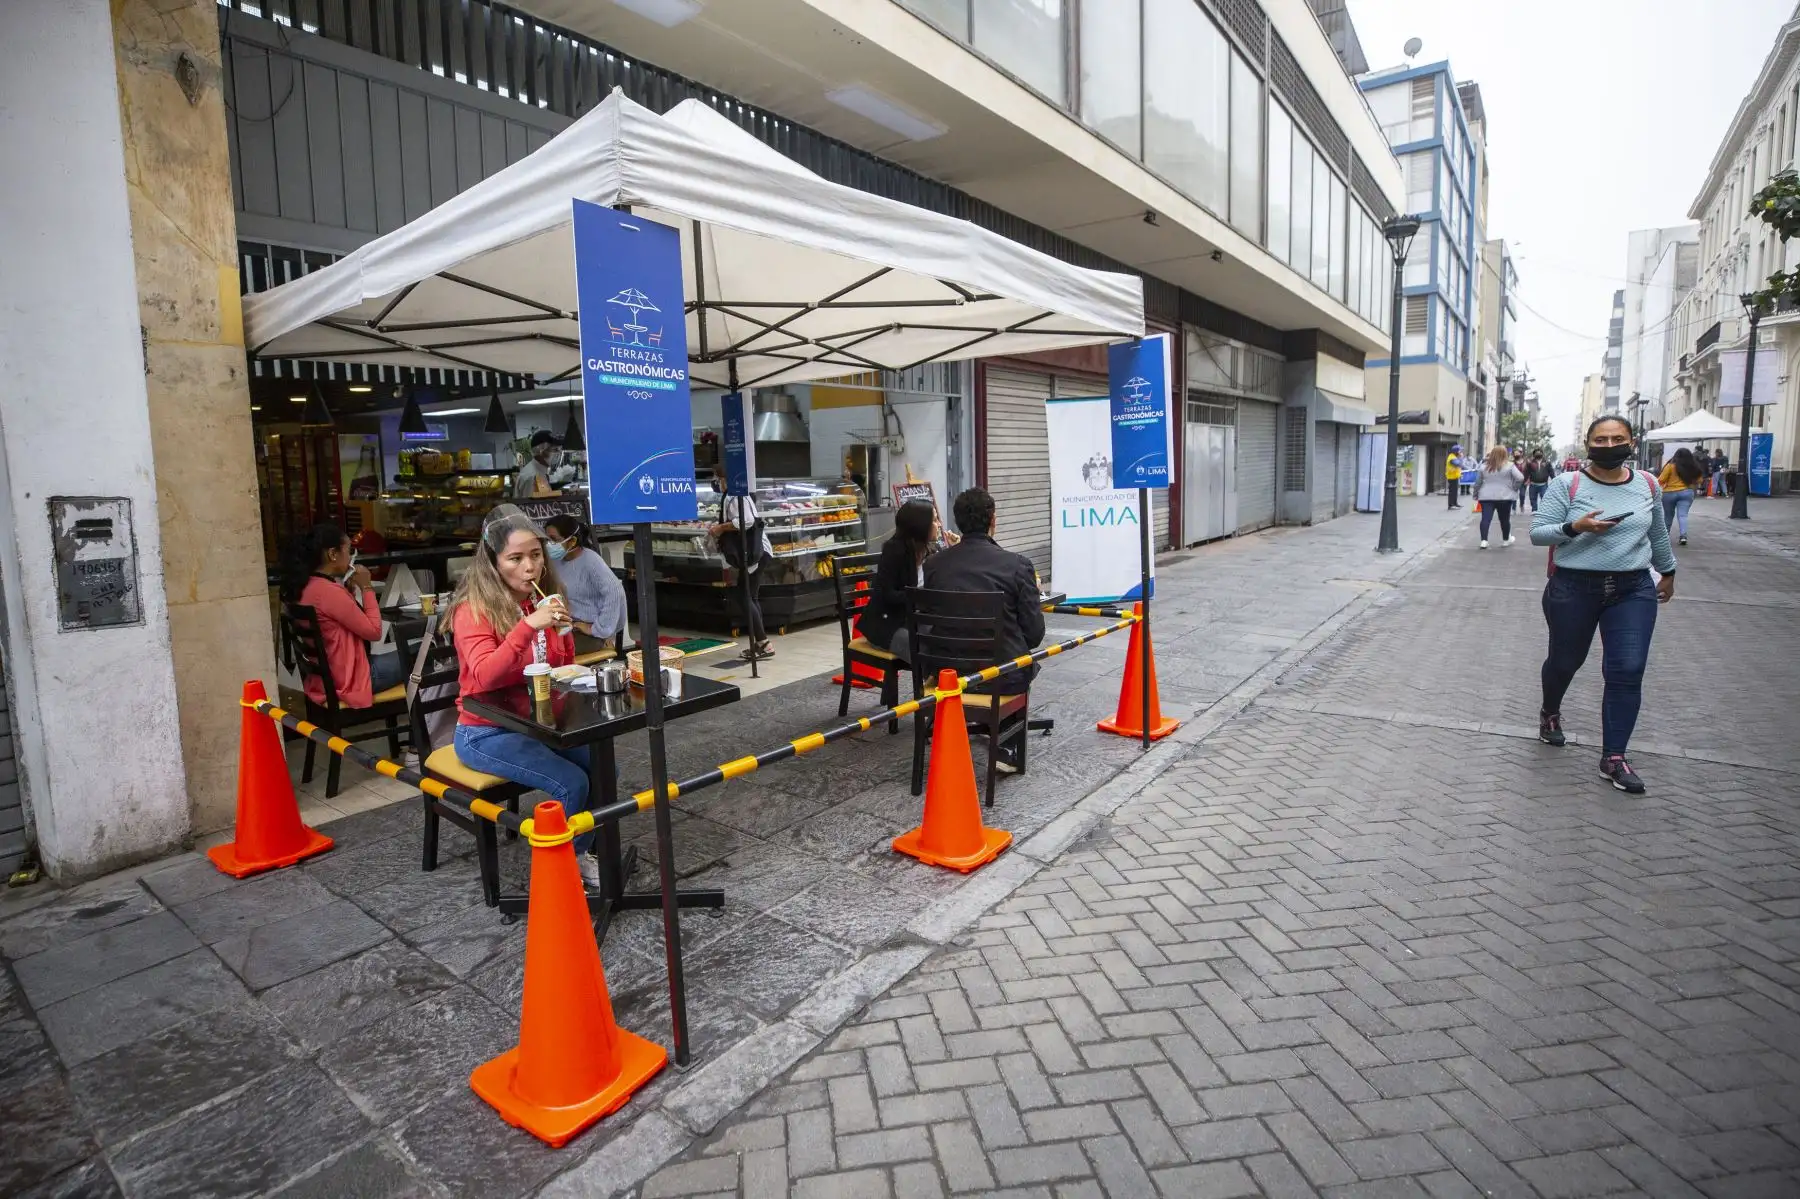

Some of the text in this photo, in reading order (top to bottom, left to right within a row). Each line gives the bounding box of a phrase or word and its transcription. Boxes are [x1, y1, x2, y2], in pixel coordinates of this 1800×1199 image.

[610, 347, 664, 363] TERRAZAS
[587, 359, 685, 380] GASTRONÓMICAS
[1124, 405, 1152, 413] TERRAZAS
[1113, 410, 1164, 421] GASTRONÓMICAS
[661, 482, 693, 494] LIMA
[1062, 492, 1137, 503] MUNICIPALIDAD DE
[1062, 506, 1138, 528] LIMA
